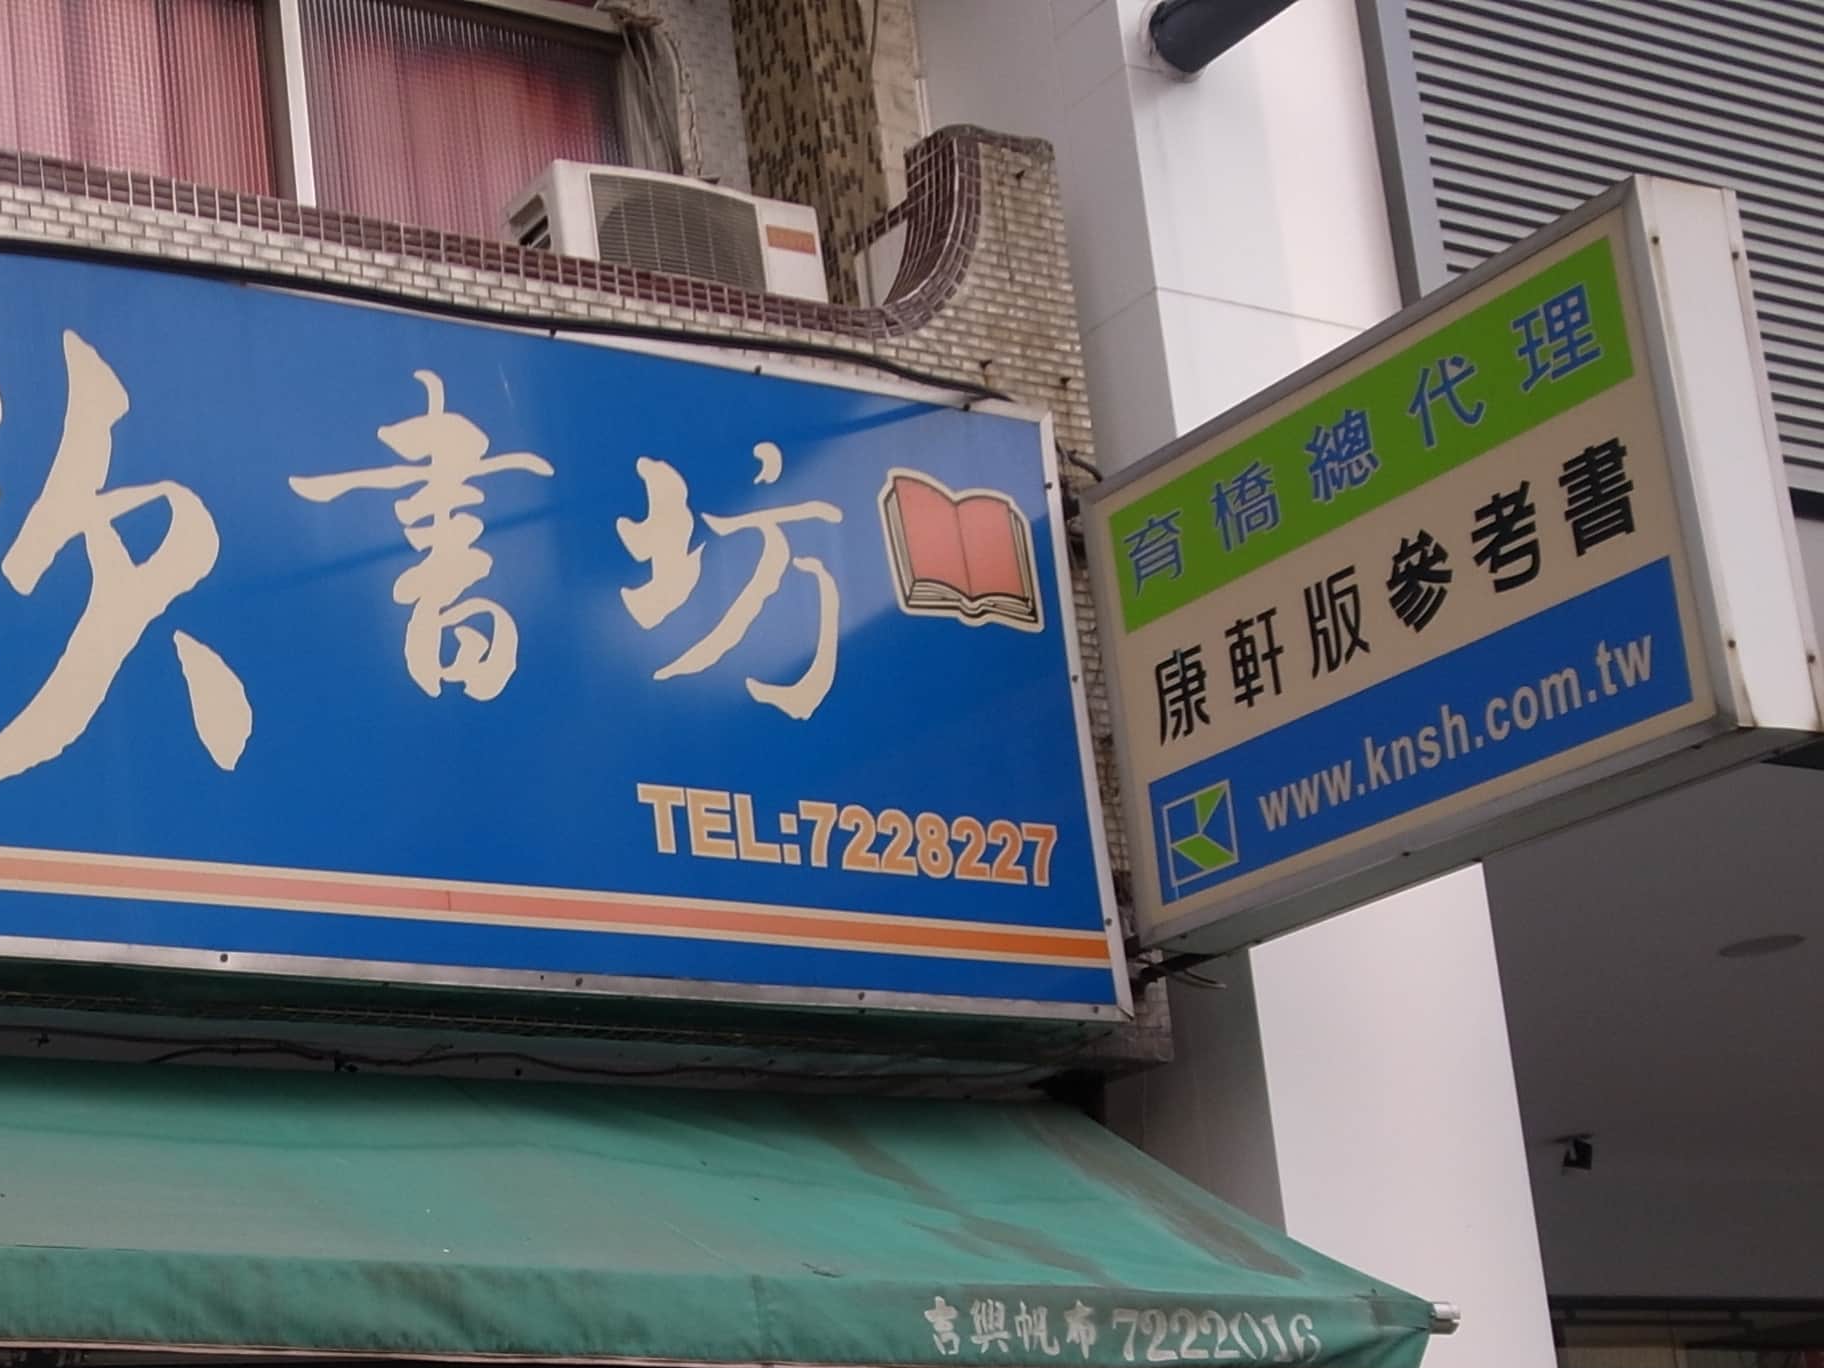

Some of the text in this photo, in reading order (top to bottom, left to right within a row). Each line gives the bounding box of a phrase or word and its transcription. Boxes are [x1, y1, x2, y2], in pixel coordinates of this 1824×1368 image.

[1123, 283, 1605, 597] 育橋總代理
[1155, 436, 1636, 749] 康軒版參考書
[1258, 633, 1654, 833] www.knsh.com.tw
[636, 783, 1058, 888] TEL:7228227
[1112, 1308, 1321, 1363] 7222016
